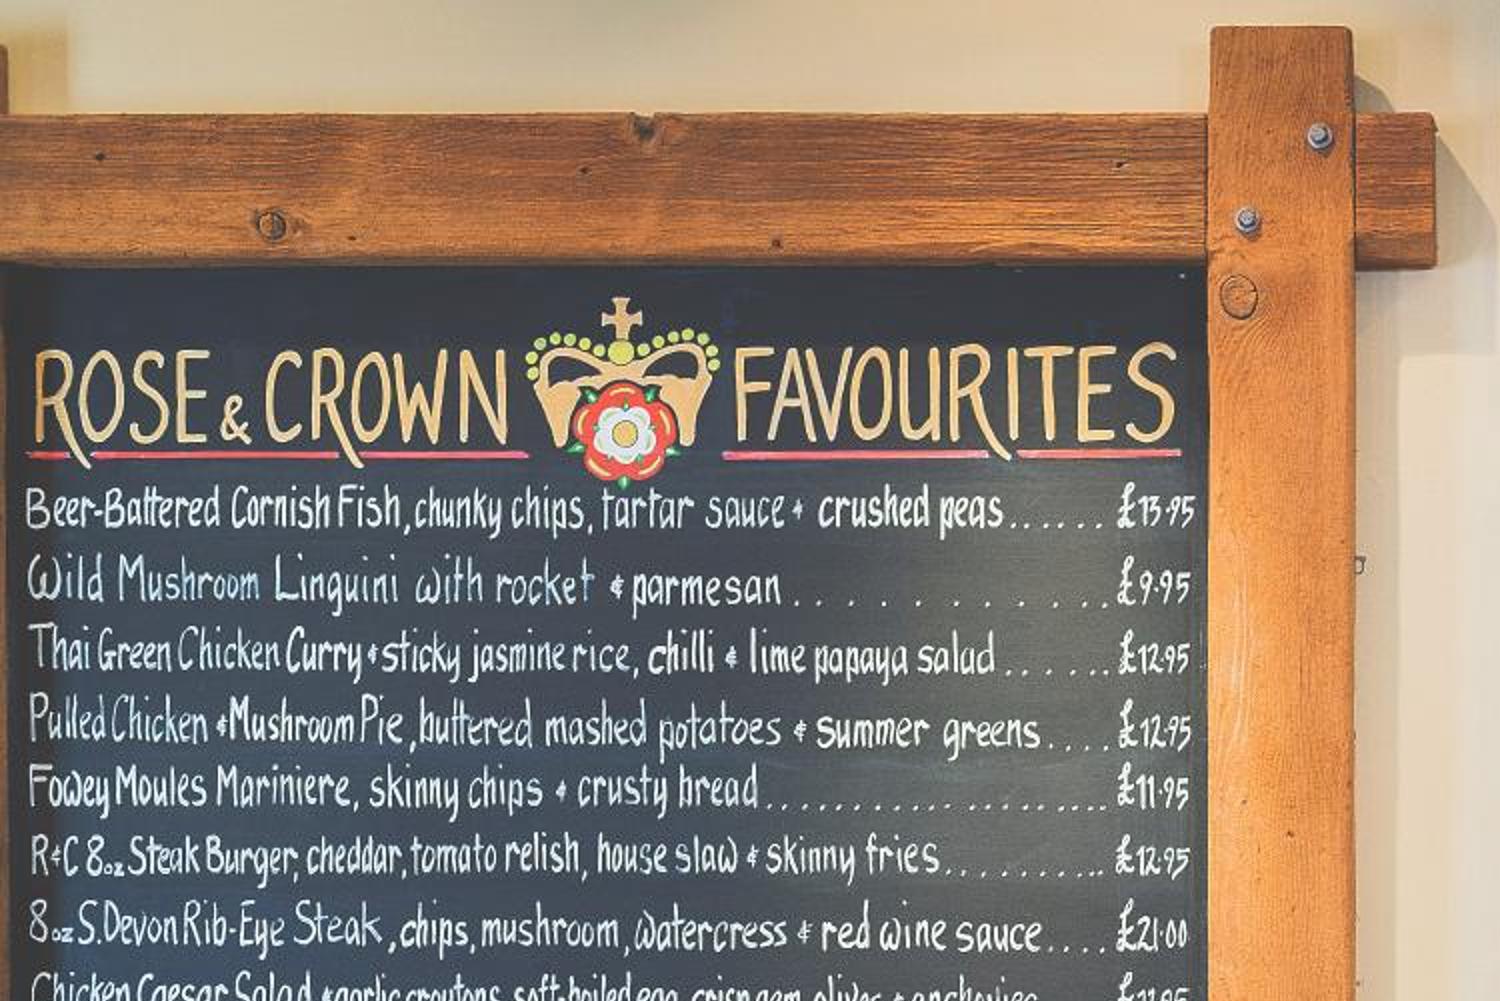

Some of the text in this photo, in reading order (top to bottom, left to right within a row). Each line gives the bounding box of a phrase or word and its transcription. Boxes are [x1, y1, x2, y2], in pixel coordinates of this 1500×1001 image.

[34, 340, 1179, 470] ROSE & CROWN FAVOURITES
[25, 484, 221, 530] Beer-Battered
[230, 484, 330, 531] Cornish
[414, 484, 502, 540] chunky
[601, 486, 695, 531] tartar
[704, 495, 786, 529] sauce
[818, 483, 930, 530] crushed
[939, 495, 1004, 541] peas
[27, 552, 104, 602] Wild
[118, 553, 261, 602] Mushroom
[274, 552, 399, 617] Linguini
[415, 552, 483, 604] with
[496, 555, 596, 606] rocket
[632, 572, 782, 621] parmesan
[27, 620, 91, 672] Thai
[97, 626, 173, 673] Green
[177, 624, 281, 672] Chicken
[284, 624, 363, 685] Curry
[380, 626, 461, 684] sticky
[467, 627, 566, 684] jasmine
[648, 628, 715, 675] chilli
[749, 626, 807, 675] lime
[813, 644, 909, 687] papaya
[916, 628, 996, 675] salad
[28, 691, 107, 743] Pulled
[110, 692, 209, 745] Chicken
[229, 694, 355, 744] Mushroom
[418, 695, 533, 749] buttered
[544, 696, 647, 748] mashed
[658, 699, 783, 765] potatoes
[815, 715, 931, 749] summer
[942, 717, 1042, 762] greens
[28, 763, 110, 820] Fowey
[114, 764, 208, 807] Moules
[368, 762, 459, 823] skinny
[467, 764, 544, 817] chips
[576, 763, 668, 820] crusty
[678, 761, 760, 809] bread
[127, 835, 201, 876] Steak
[409, 833, 498, 877] tomato
[597, 832, 668, 875] house
[674, 834, 739, 875] slaw
[765, 834, 856, 887] skinny
[864, 832, 941, 875] fries
[183, 899, 286, 961] Rib-Eye
[633, 901, 789, 953] watercress
[821, 898, 871, 952] red
[878, 899, 947, 951] wine
[955, 921, 1043, 953] sauce
